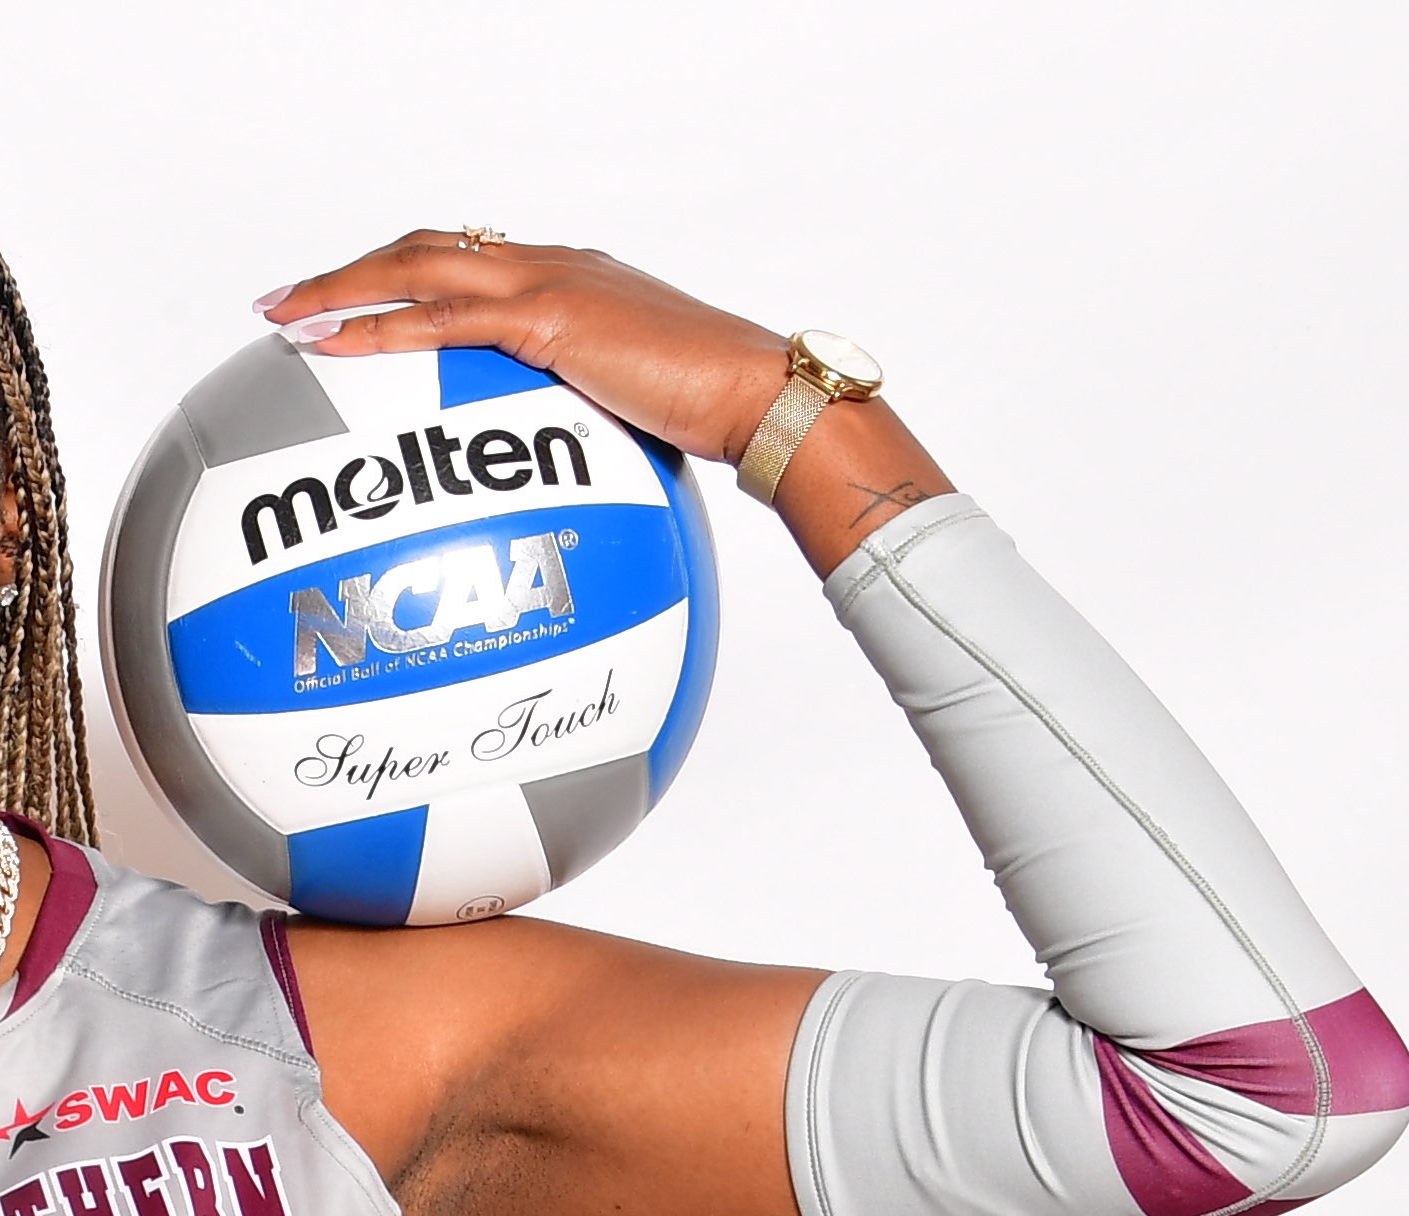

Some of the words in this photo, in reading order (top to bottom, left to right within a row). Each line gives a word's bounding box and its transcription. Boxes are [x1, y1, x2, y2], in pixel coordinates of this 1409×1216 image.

[293, 668, 347, 694] Official
[351, 660, 381, 681] Ball
[384, 659, 401, 674] of
[405, 647, 448, 668] NCAA
[294, 733, 450, 800] Super
[471, 668, 620, 762] Touch
